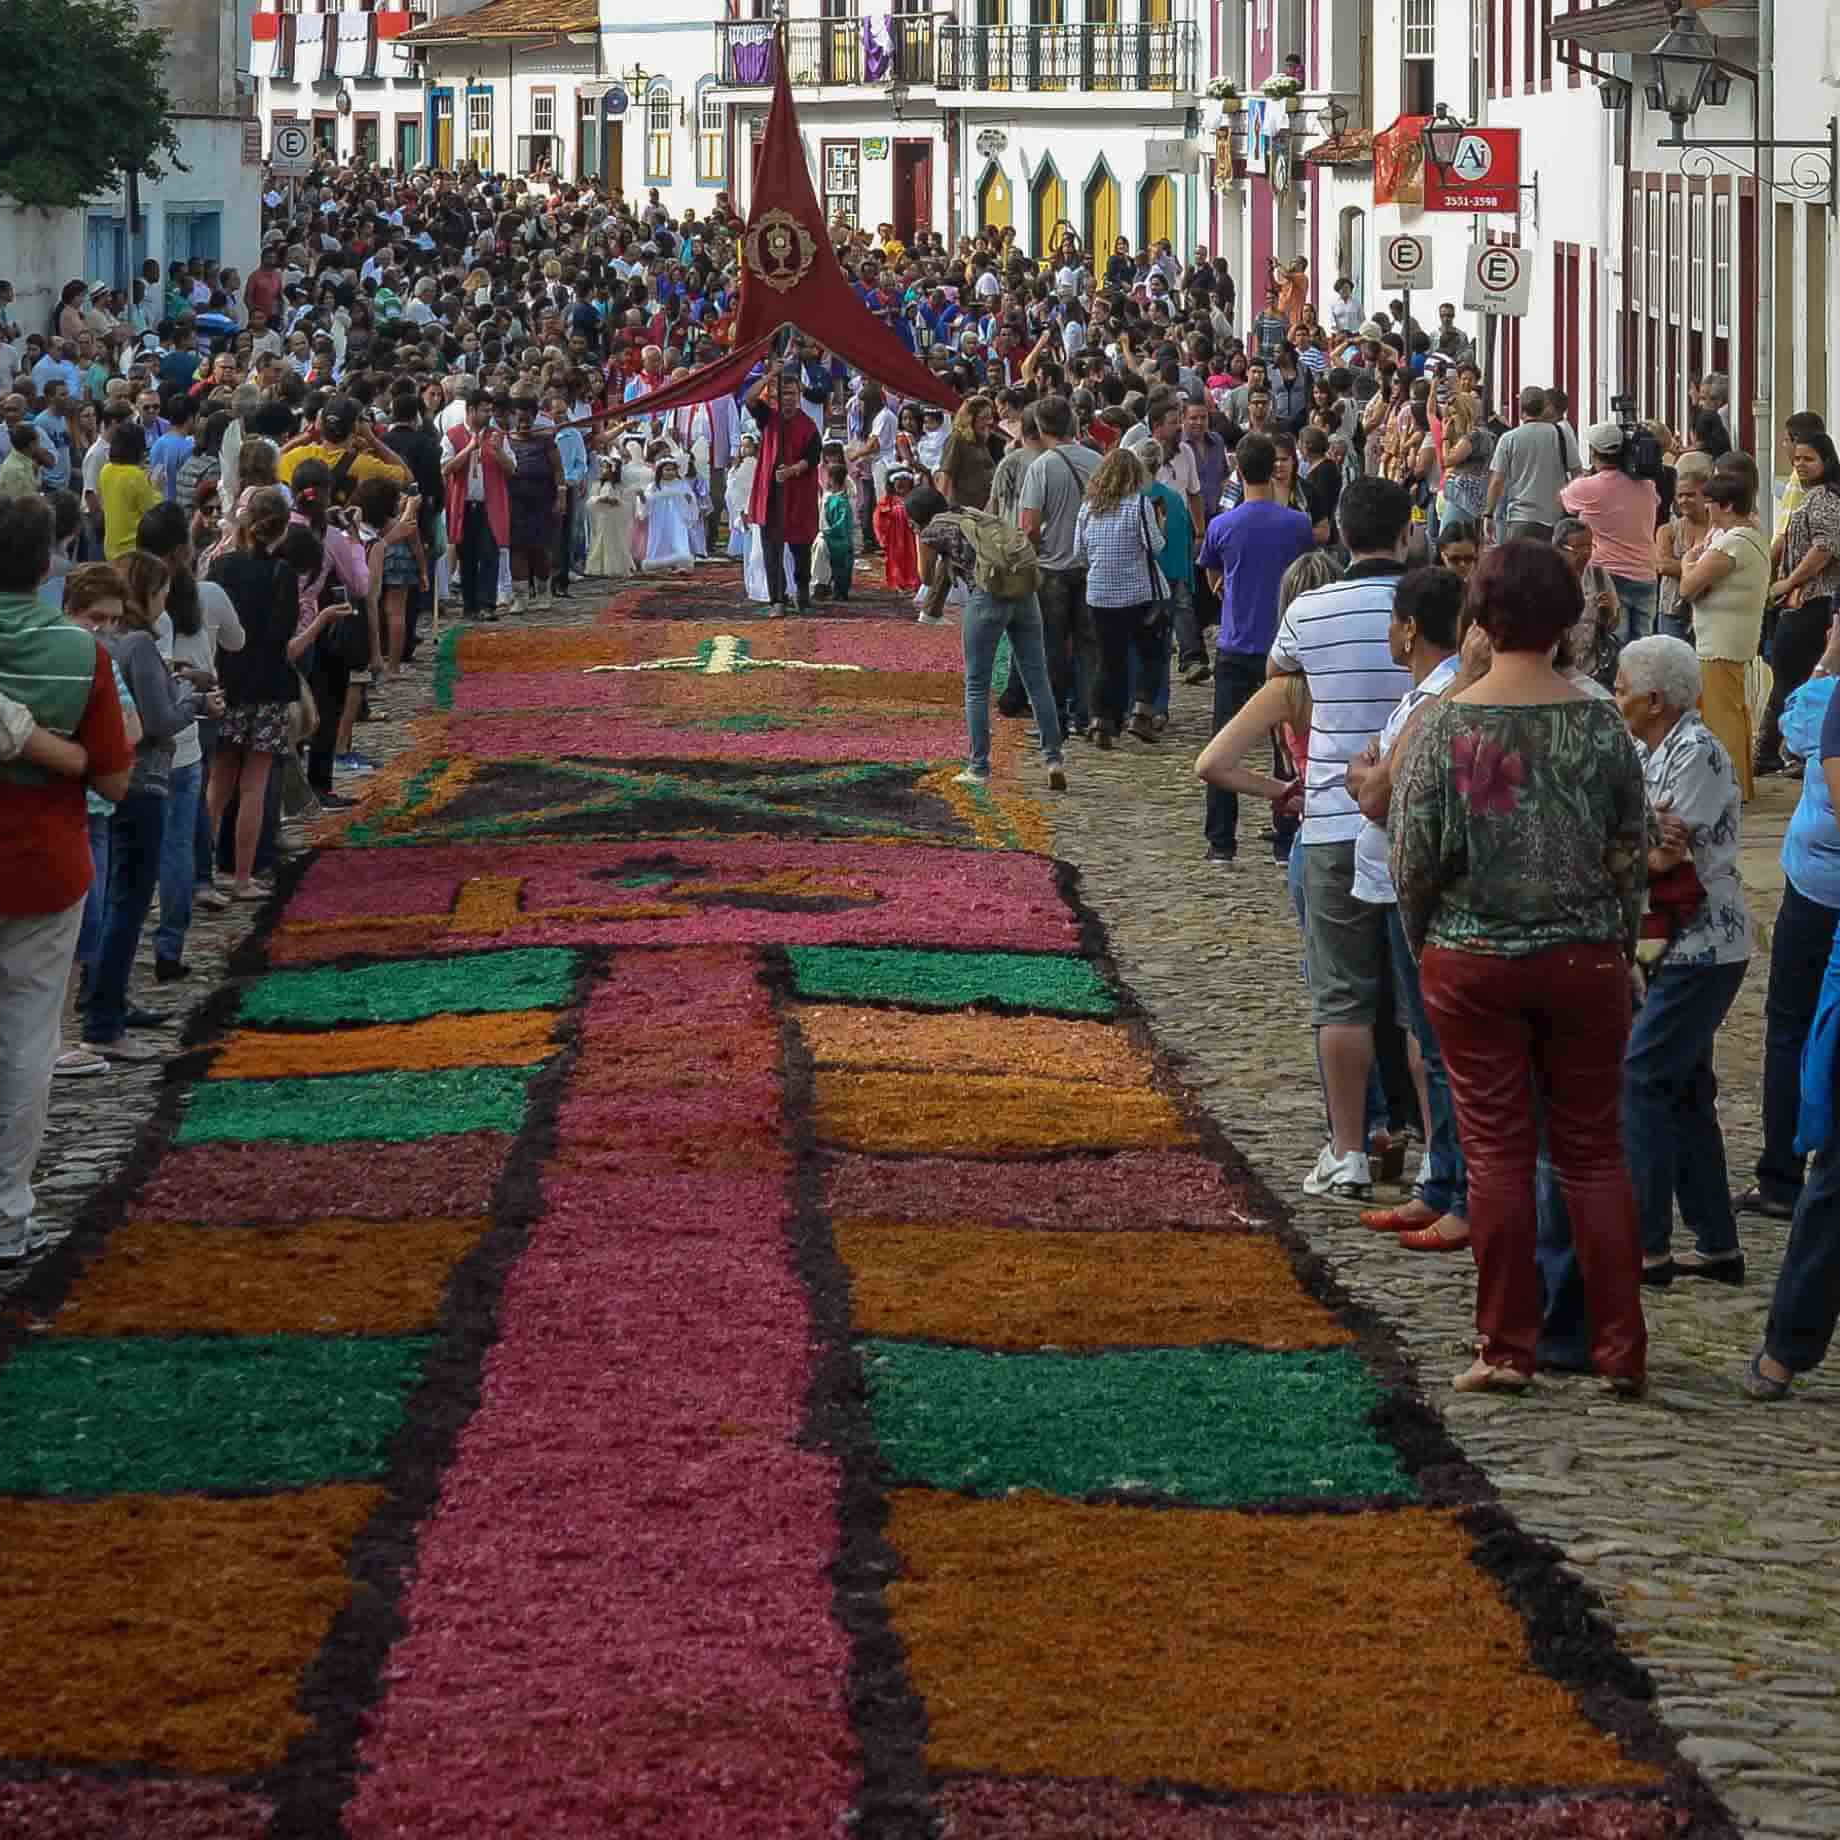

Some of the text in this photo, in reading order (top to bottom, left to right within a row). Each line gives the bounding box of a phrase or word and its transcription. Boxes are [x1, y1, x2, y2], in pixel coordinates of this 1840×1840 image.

[286, 132, 298, 153] E
[1397, 244, 1414, 264] E
[1487, 257, 1509, 282] E
